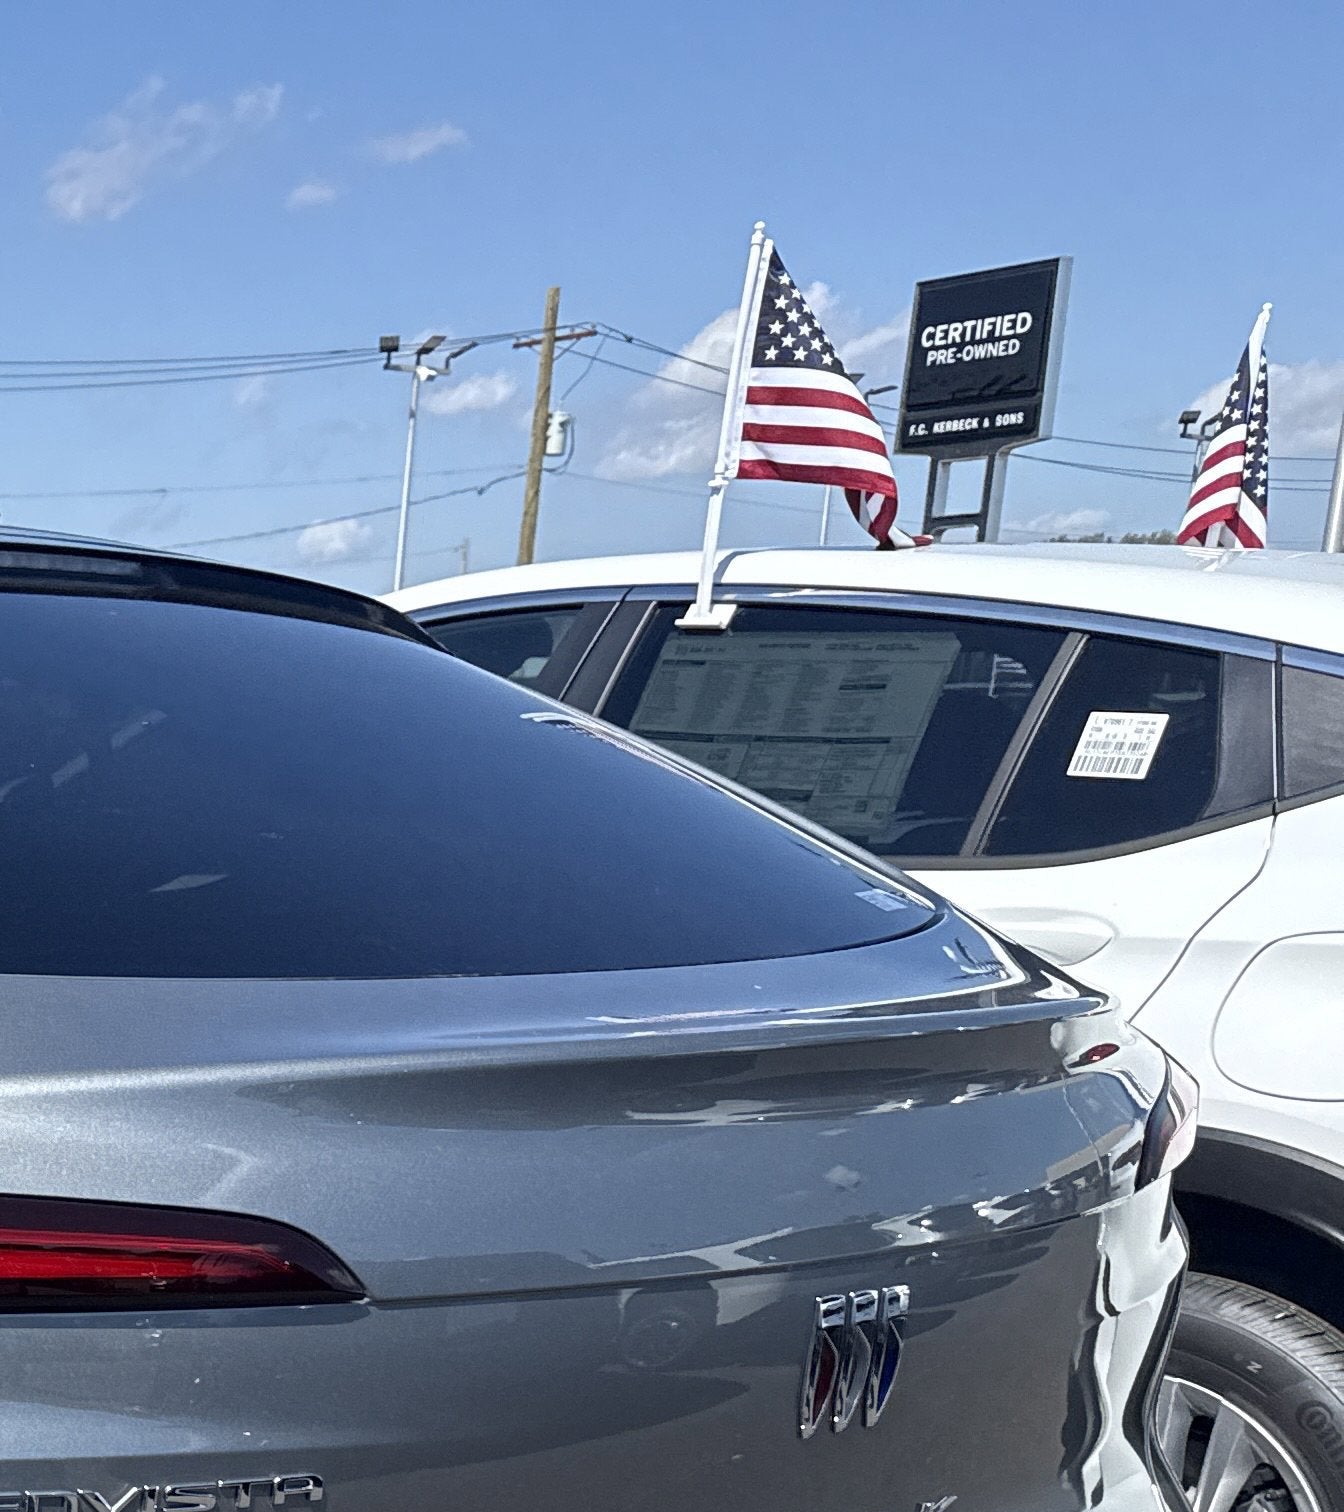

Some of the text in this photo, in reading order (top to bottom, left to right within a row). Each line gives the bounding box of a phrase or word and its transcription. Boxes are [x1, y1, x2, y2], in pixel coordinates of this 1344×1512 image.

[920, 311, 1033, 348] CERTIFIED
[926, 338, 1020, 367] PRE-OWNED
[909, 424, 928, 437] F.C.
[932, 417, 980, 434] KERBECK
[995, 411, 1025, 427] SONS
